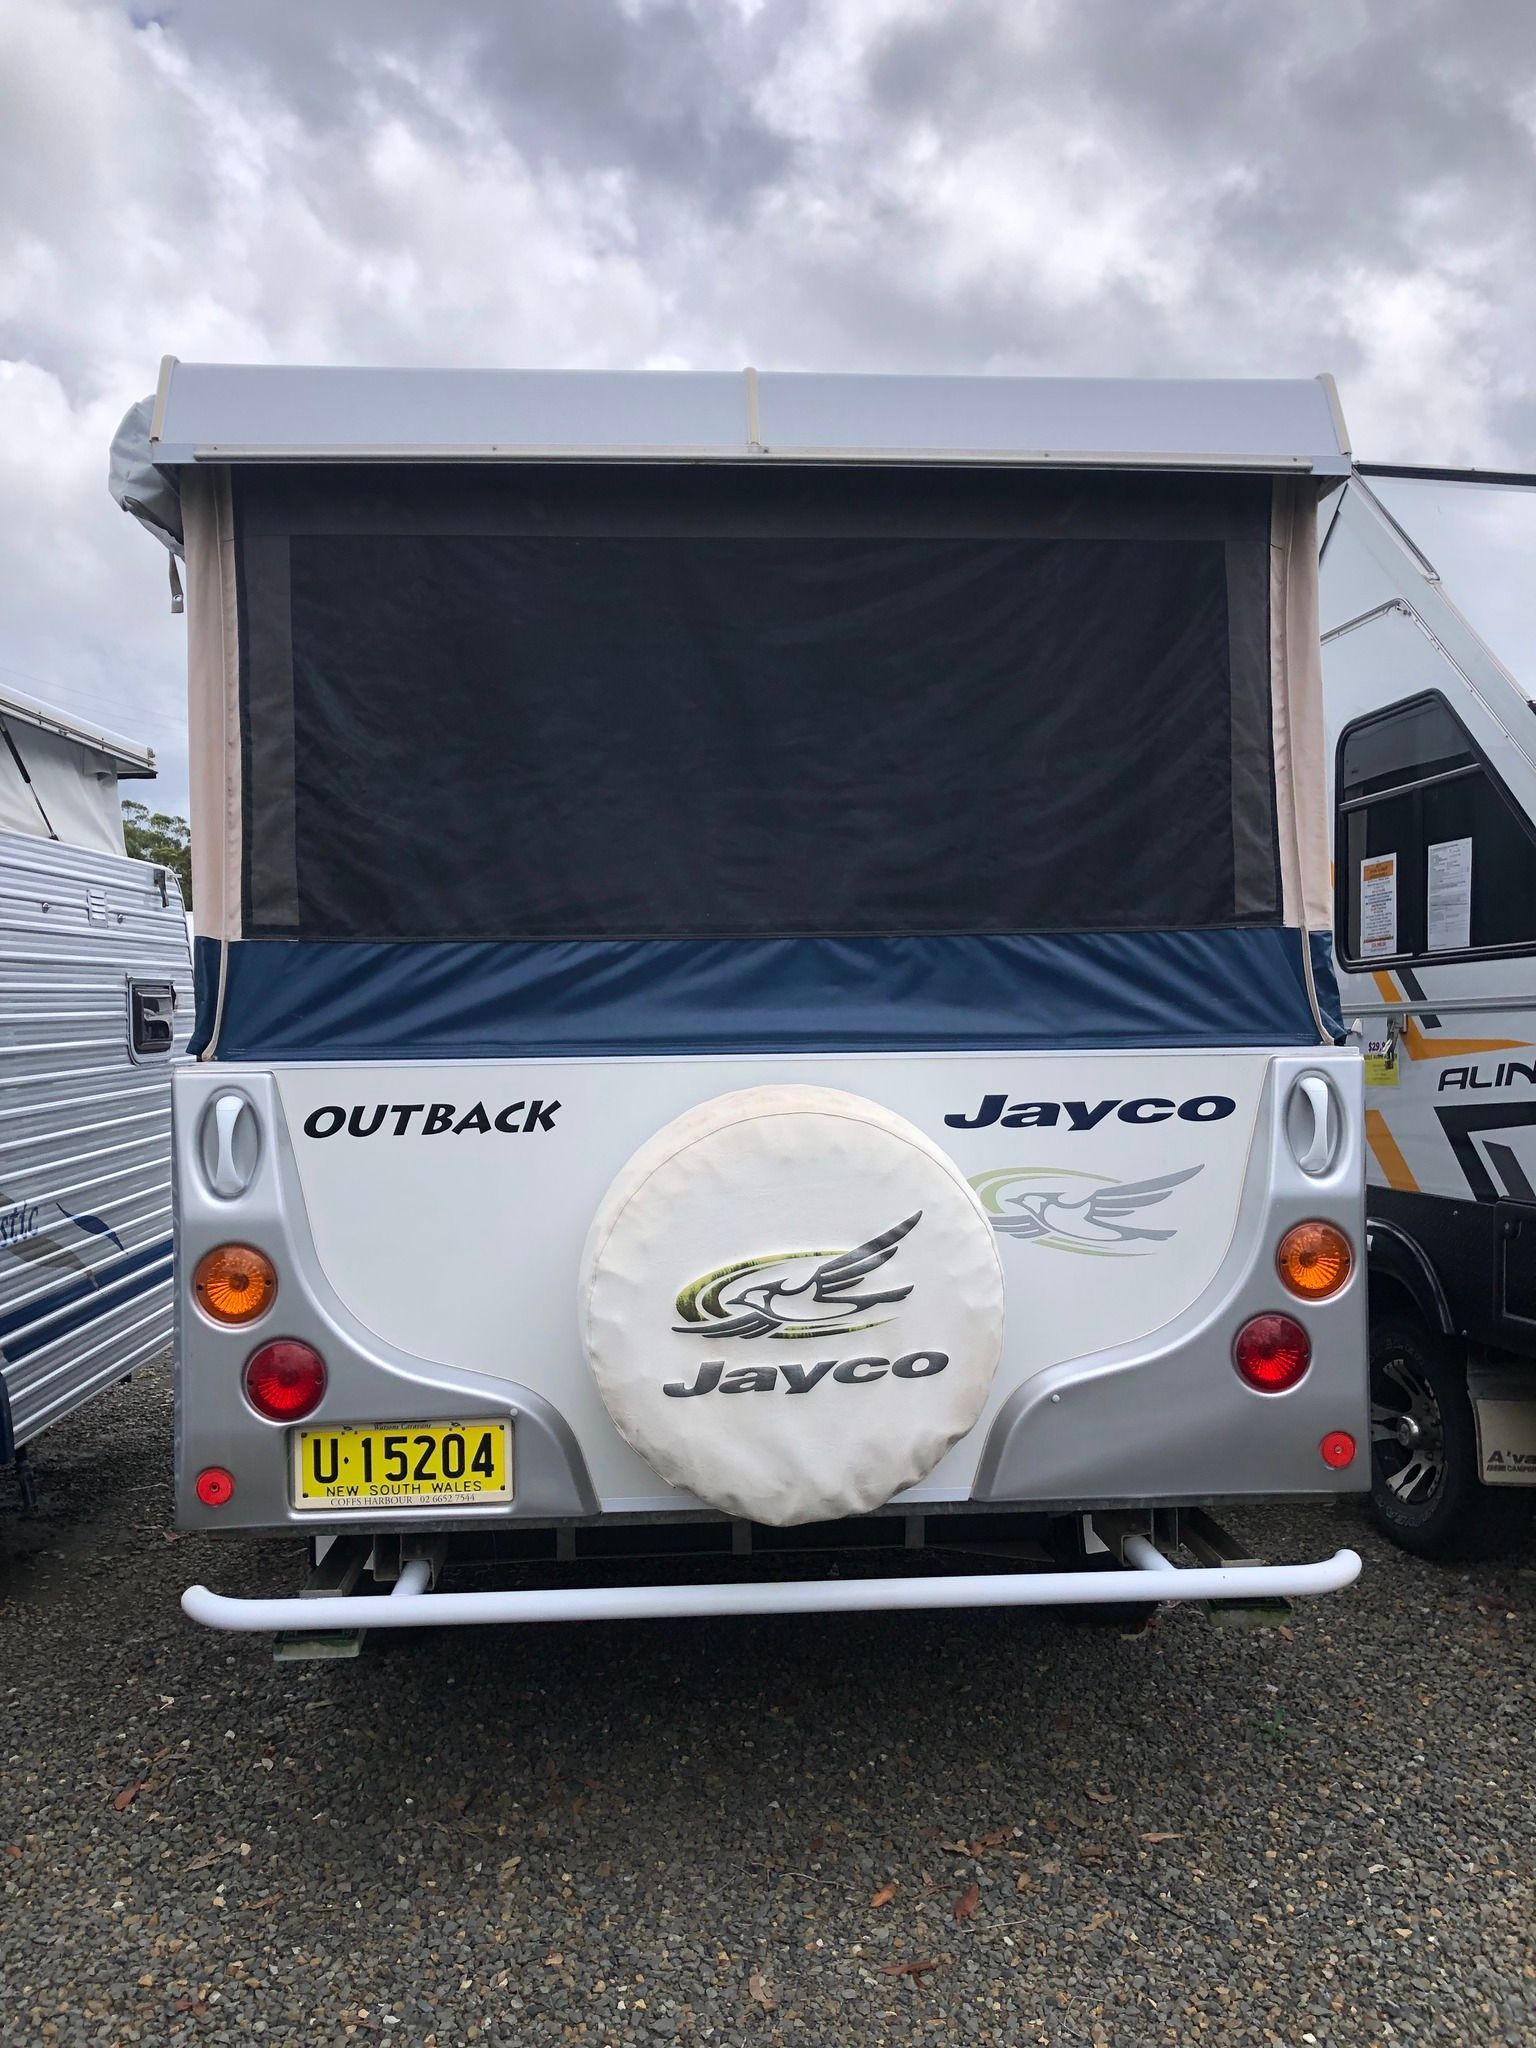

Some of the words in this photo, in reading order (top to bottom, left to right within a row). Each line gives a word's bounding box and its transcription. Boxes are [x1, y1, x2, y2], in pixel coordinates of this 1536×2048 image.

[304, 1100, 561, 1138] OUTBACK
[944, 1095, 1236, 1131] Jayco
[663, 1352, 949, 1398] Jayco
[326, 1485, 359, 1496] NEW
[369, 1483, 421, 1496] SOUTH
[431, 1480, 482, 1493] WALES
[330, 1497, 362, 1506] COFFS
[364, 1495, 413, 1505] HARBOUR
[419, 1494, 430, 1503] 02
[432, 1494, 453, 1503] 6652
[454, 1493, 476, 1502] 7544
